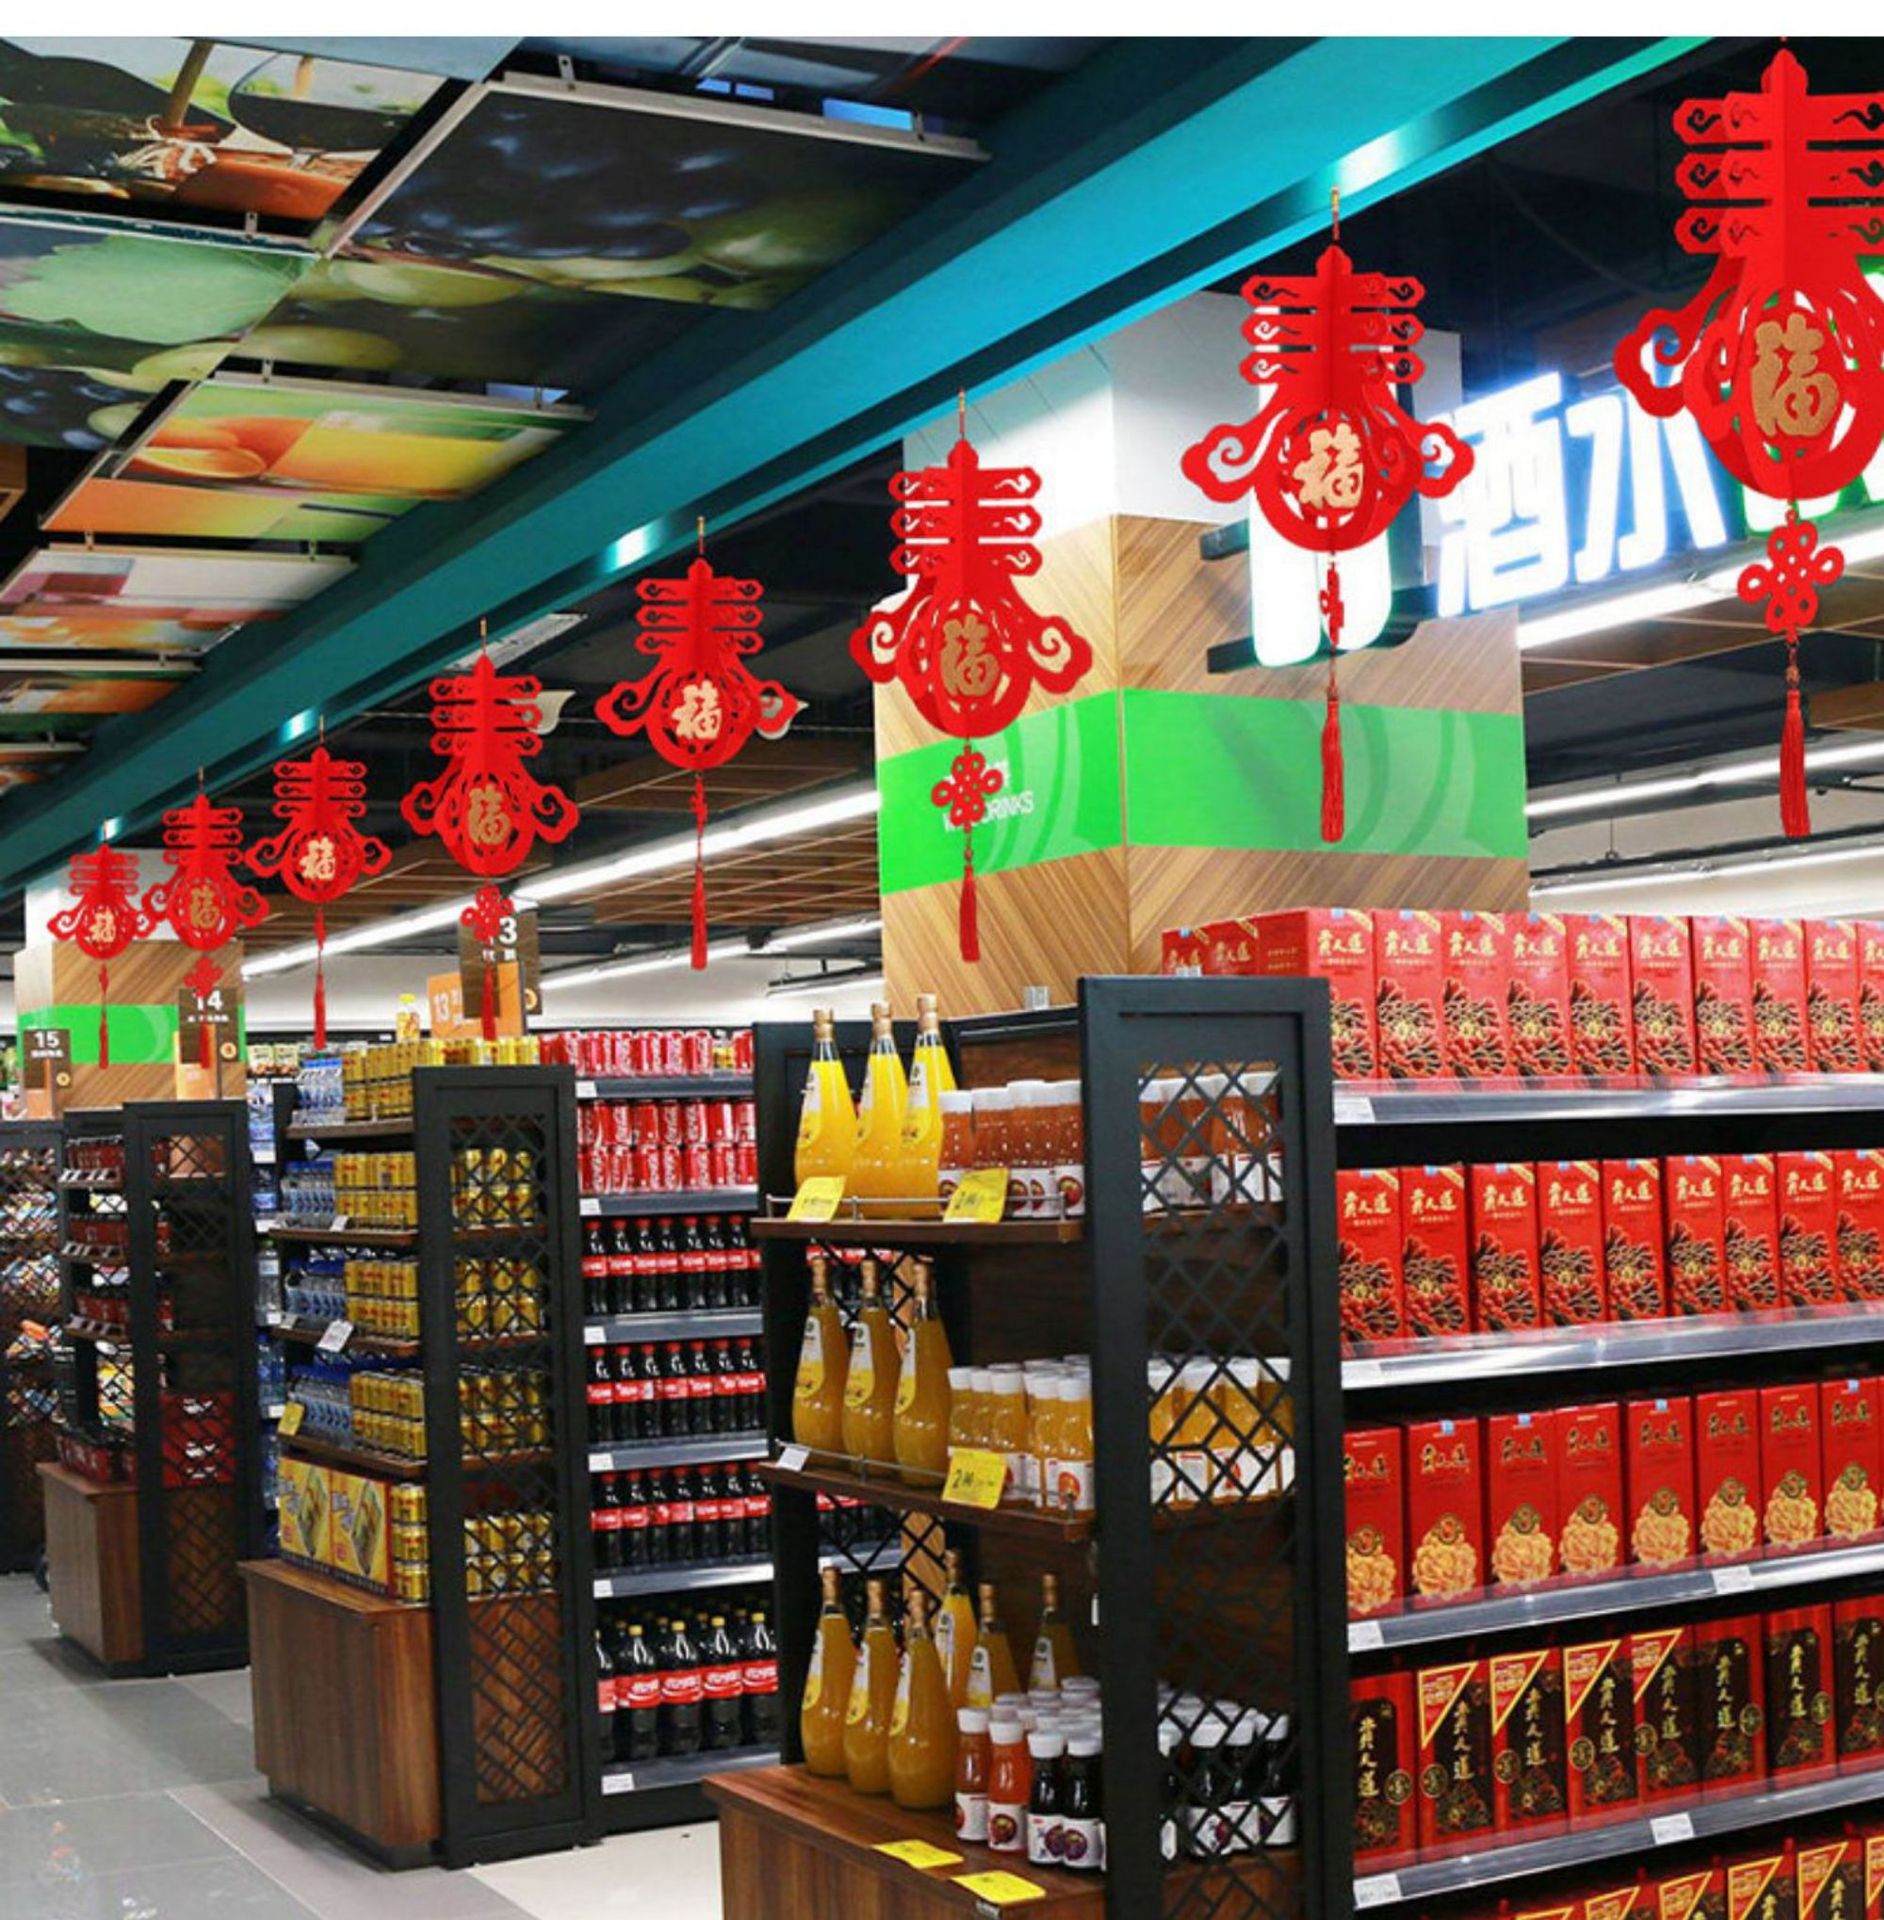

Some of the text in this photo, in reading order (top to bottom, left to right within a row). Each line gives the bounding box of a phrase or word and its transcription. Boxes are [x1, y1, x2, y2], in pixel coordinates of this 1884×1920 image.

[1752, 312, 1839, 437] 福
[1293, 422, 1363, 509] 福
[1427, 371, 1728, 617] 酒水
[938, 613, 999, 696] 福
[671, 679, 722, 739] 福
[468, 783, 511, 845] 福
[34, 1031, 60, 1048] 15
